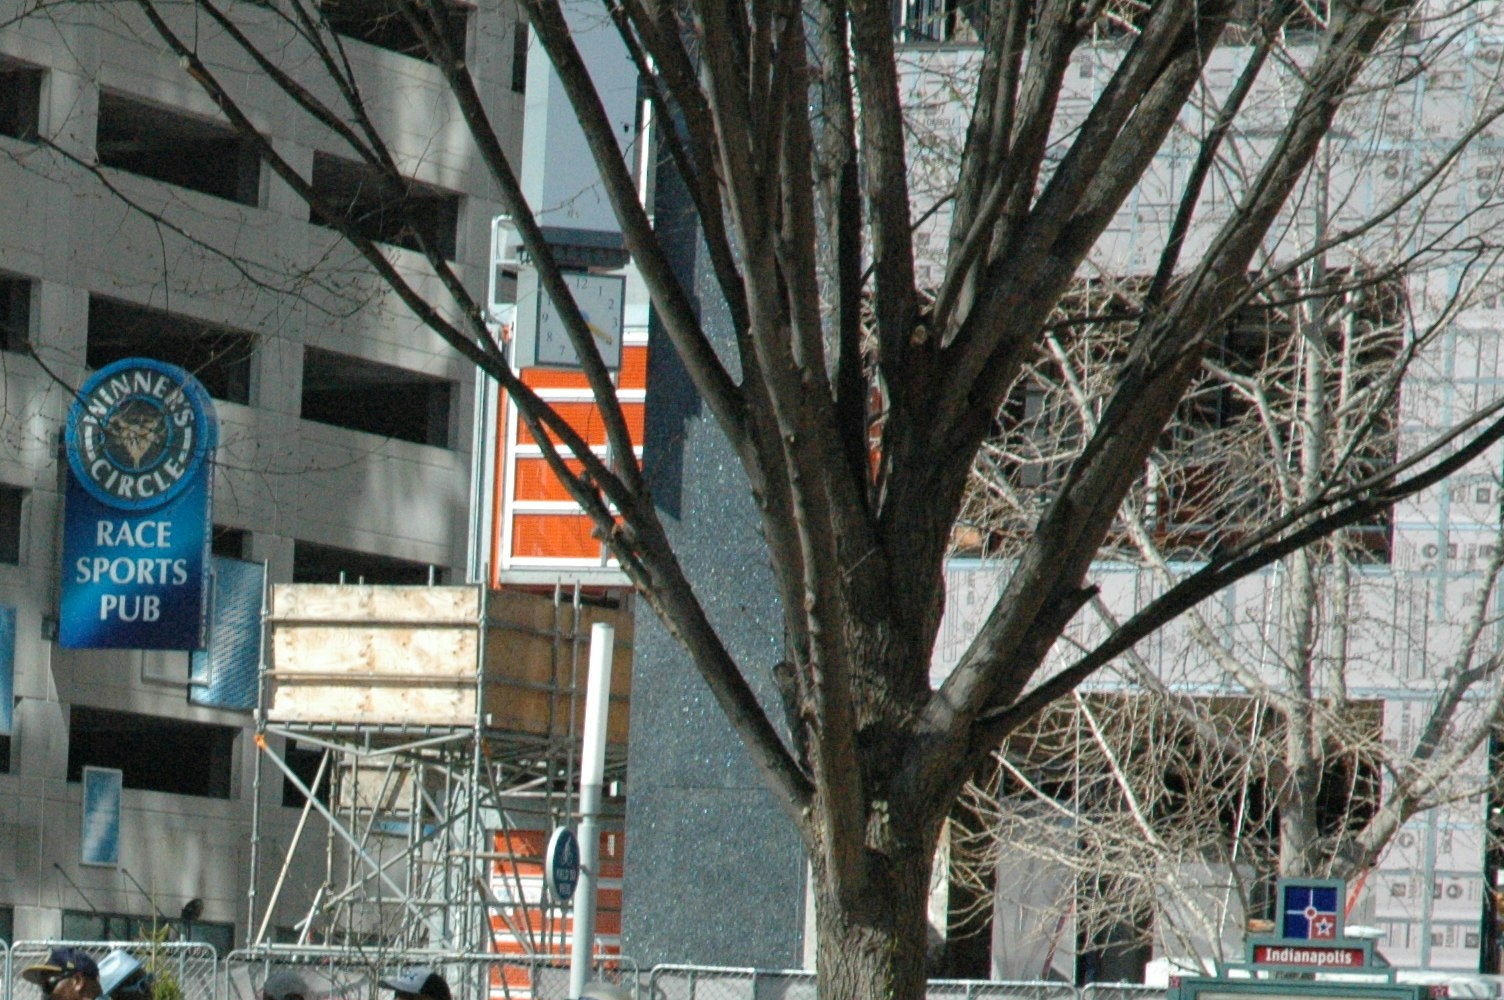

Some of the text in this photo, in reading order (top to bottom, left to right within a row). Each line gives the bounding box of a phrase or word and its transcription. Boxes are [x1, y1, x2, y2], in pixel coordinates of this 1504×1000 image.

[576, 277, 588, 289] 12
[82, 370, 195, 427] WINNER'S
[90, 457, 186, 498] CIRCLE
[96, 519, 172, 548] RACE
[76, 556, 188, 586] SPORTS
[100, 593, 161, 622] PUB
[1265, 947, 1353, 966] Indianapolis
